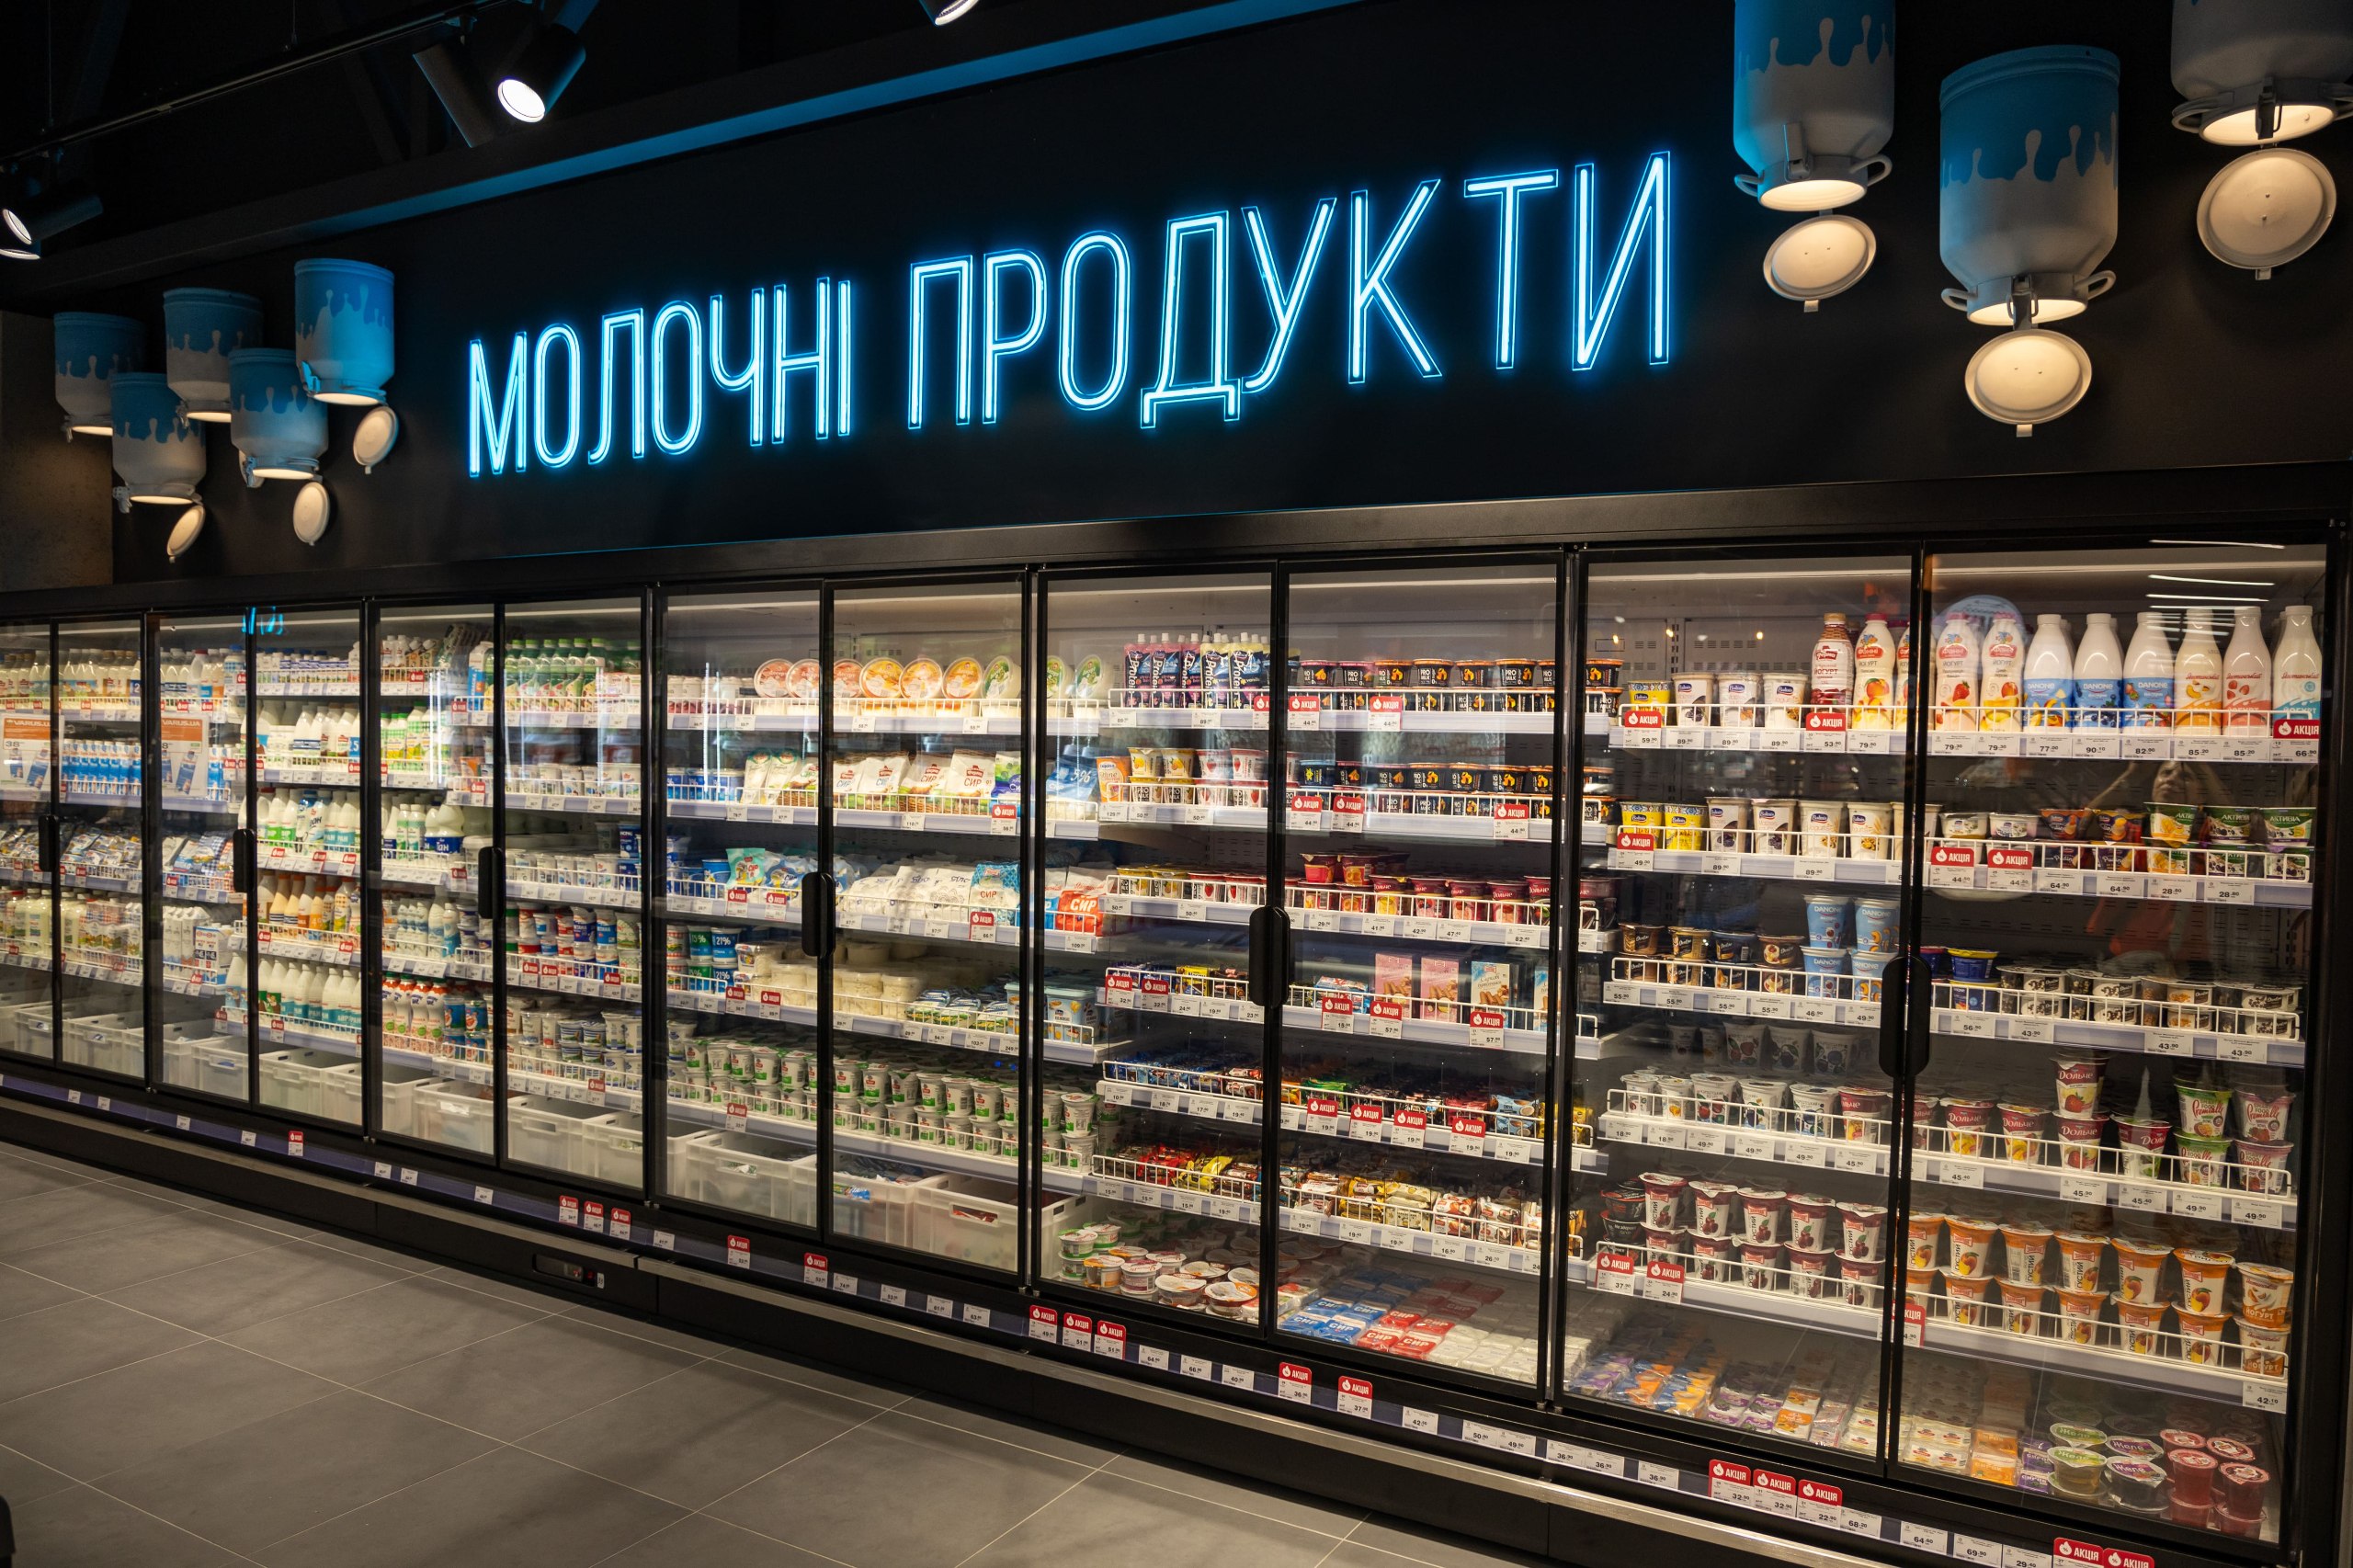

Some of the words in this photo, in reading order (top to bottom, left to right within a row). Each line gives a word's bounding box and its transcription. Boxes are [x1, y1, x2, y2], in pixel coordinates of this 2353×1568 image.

[469, 278, 851, 476] МОЛОЧНІ
[909, 152, 1670, 428] ПРОДУКТИ
[1822, 718, 1842, 726] АКЦІЯ
[2293, 725, 2319, 735] АКЦІЯ
[1303, 800, 1318, 808] АКЦІЯ
[1346, 801, 1360, 810] АКЦІЯ
[1632, 838, 1650, 846] АКЦІЯ
[1949, 853, 1971, 862] АКЦІЯ
[2006, 855, 2028, 865] АКЦІЯ
[1070, 899, 1097, 912] СИР
[716, 971, 730, 980] 21%
[1153, 983, 1166, 991] АКЦІЯ
[1335, 1002, 1349, 1010] АКЦІЯ
[1382, 1006, 1399, 1016] АКЦІЯ
[1483, 1017, 1500, 1026] АКЦІЯ
[2059, 1070, 2094, 1080] Дольче
[1320, 1104, 1335, 1112] АКЦІЯ
[1363, 1110, 1379, 1119] АКЦІЯ
[1948, 1113, 1981, 1122] Дольче
[2003, 1118, 2034, 1127] Дольче
[1465, 1125, 1482, 1133] АКЦІЯ
[2062, 1126, 2097, 1135] Дольче
[1611, 1261, 1630, 1269] АКЦІЯ
[1662, 1268, 1680, 1278] АКЦІЯ
[1041, 1312, 1054, 1322] АКЦІЯ
[1904, 1310, 1921, 1320] КЦІЯ
[2246, 1309, 2273, 1319] ЙОГУРТ
[1075, 1320, 1088, 1329] АКЦІЯ
[1108, 1327, 1122, 1337] АКЦІЯ
[1367, 1332, 1392, 1341] СИР
[1403, 1337, 1428, 1346] СИР
[1291, 1369, 1308, 1381] АКЦІЯ
[1352, 1384, 1369, 1395] АКЦІЯ
[2114, 1462, 2145, 1473] Желе
[1725, 1469, 1746, 1481] АКЦІЯ
[1770, 1479, 1791, 1491] АКЦІЯ
[1815, 1489, 1837, 1501] АКЦІЯ
[2074, 1548, 2098, 1561] АКЦІЯ
[2123, 1559, 2149, 1568] АКЦІЯ
